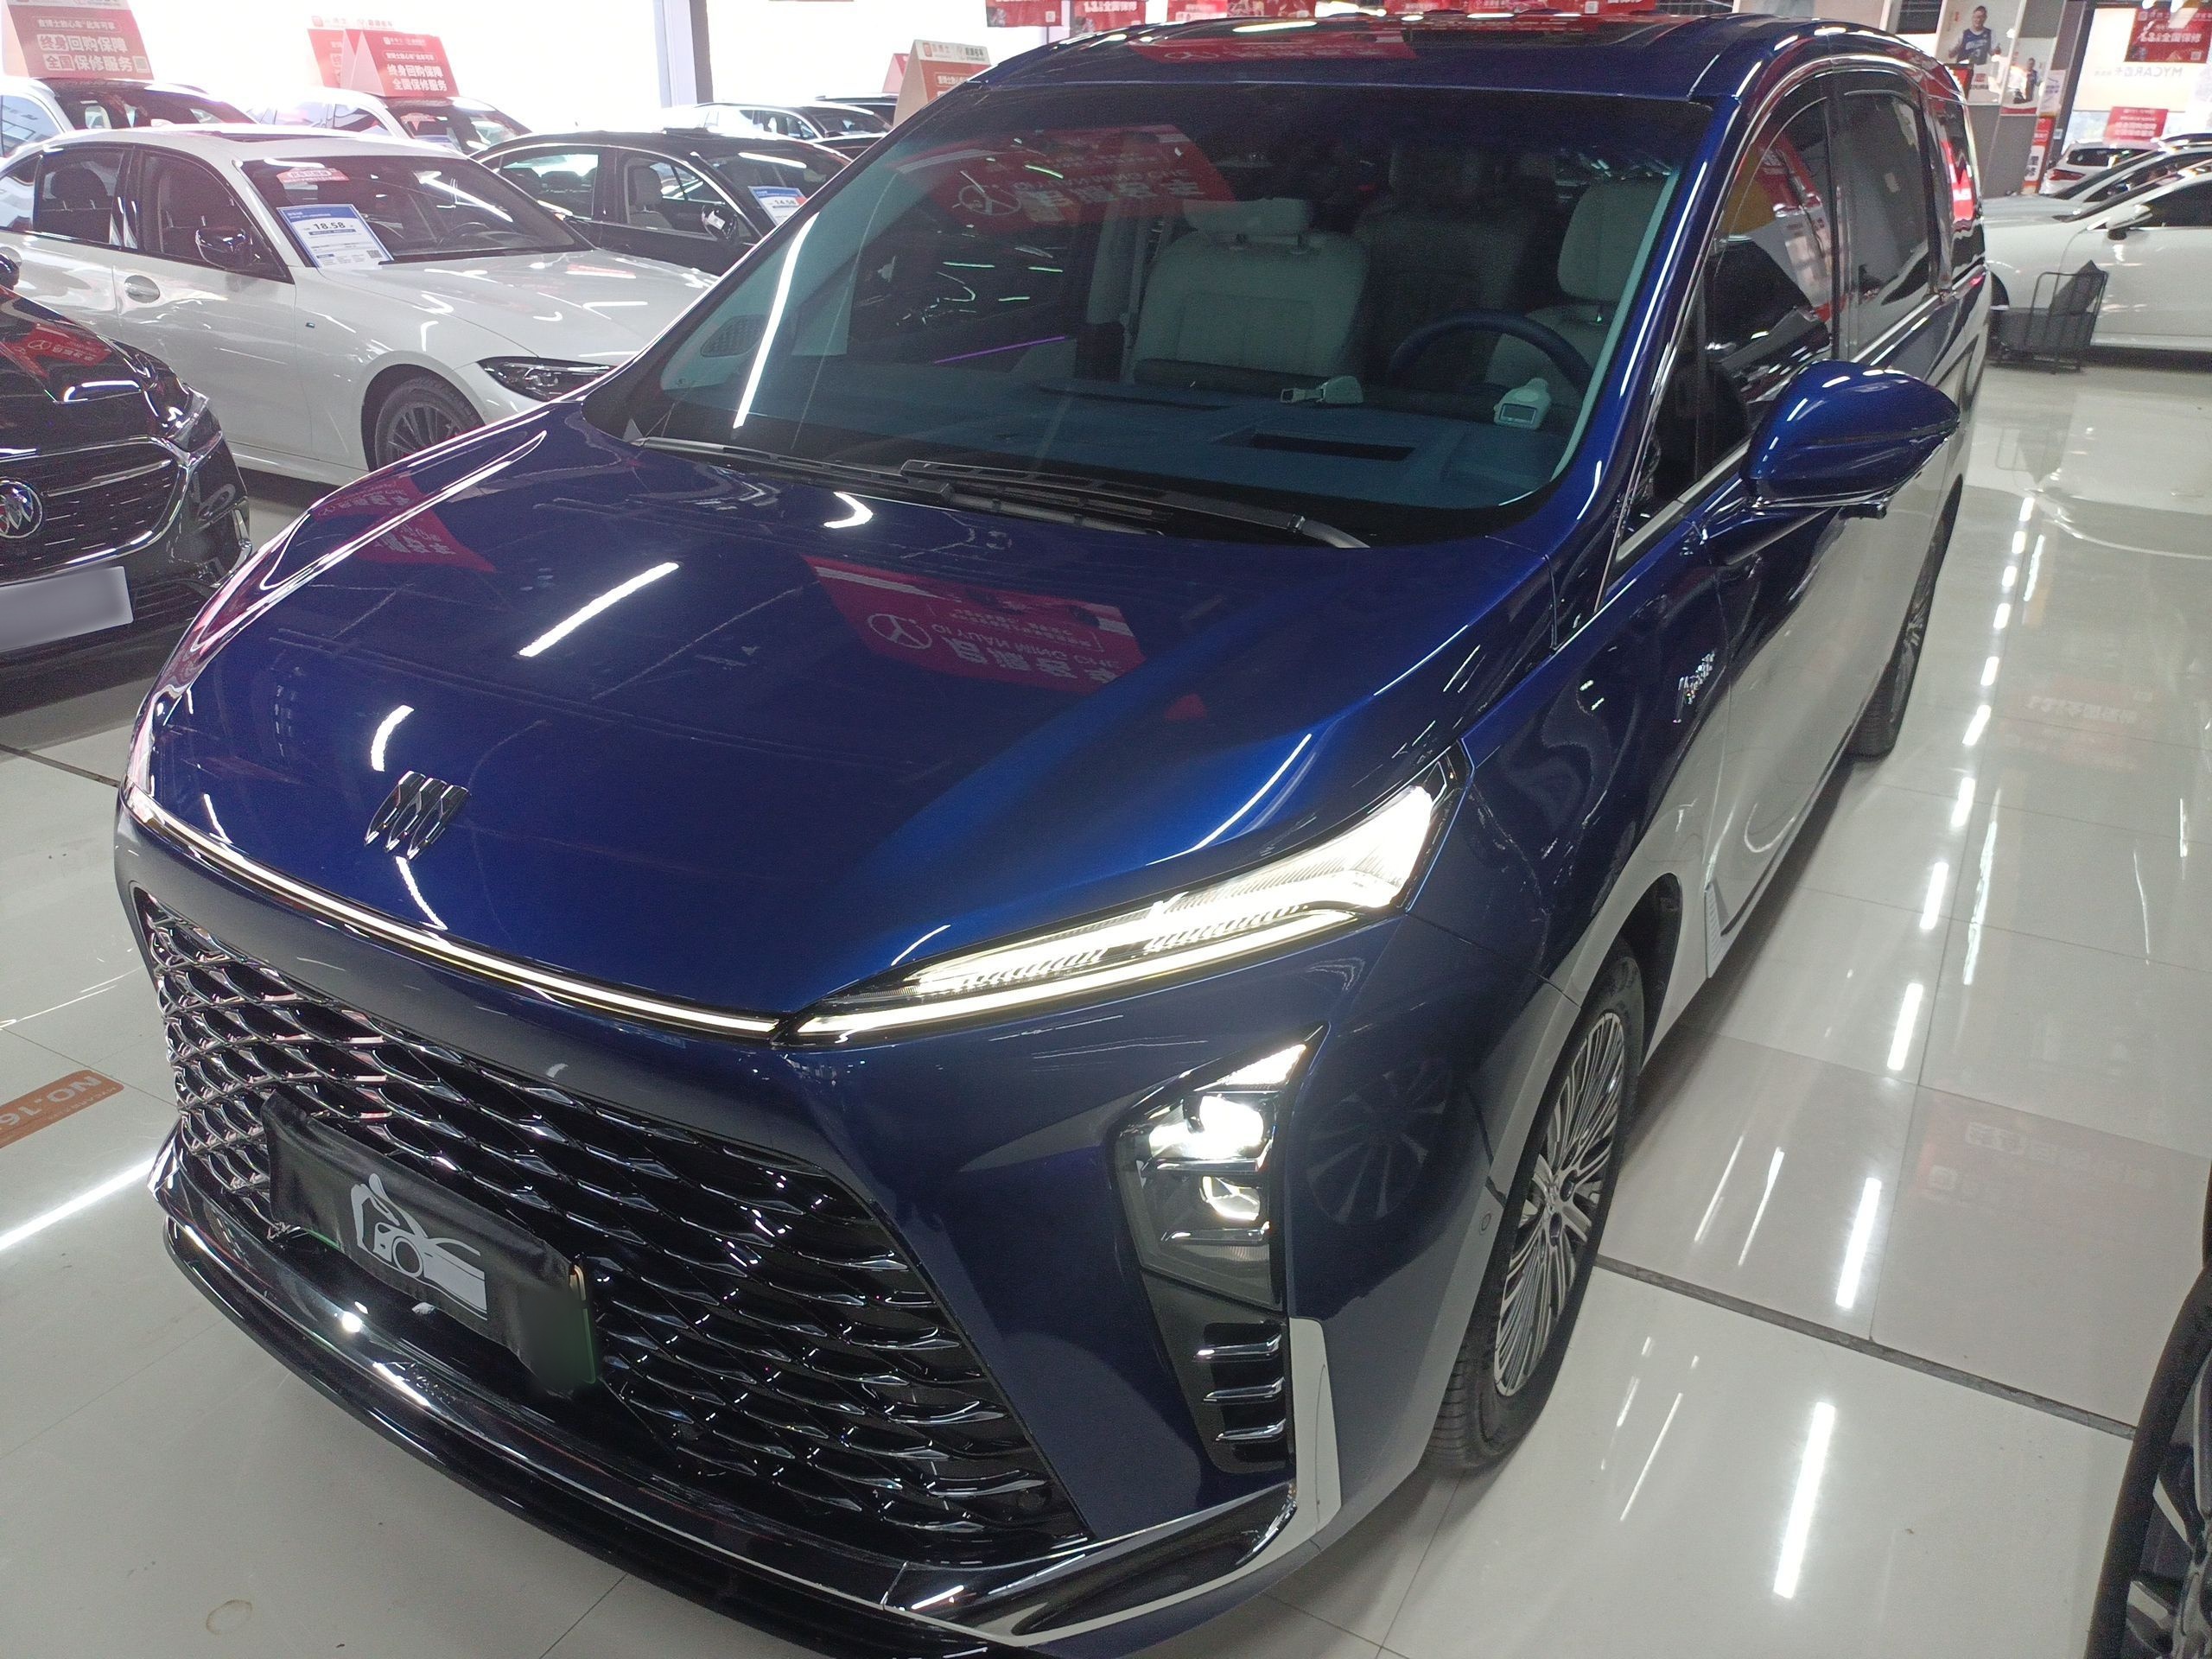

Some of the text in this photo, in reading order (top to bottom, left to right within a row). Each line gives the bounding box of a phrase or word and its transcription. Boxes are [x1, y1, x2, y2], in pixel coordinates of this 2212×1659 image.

[37, 34, 129, 53] 终身回购保障
[44, 54, 133, 72] 全国保修服务
[387, 64, 444, 77] 终身回购保障
[391, 79, 448, 92] 全国保修服务
[314, 222, 346, 231] 18.58
